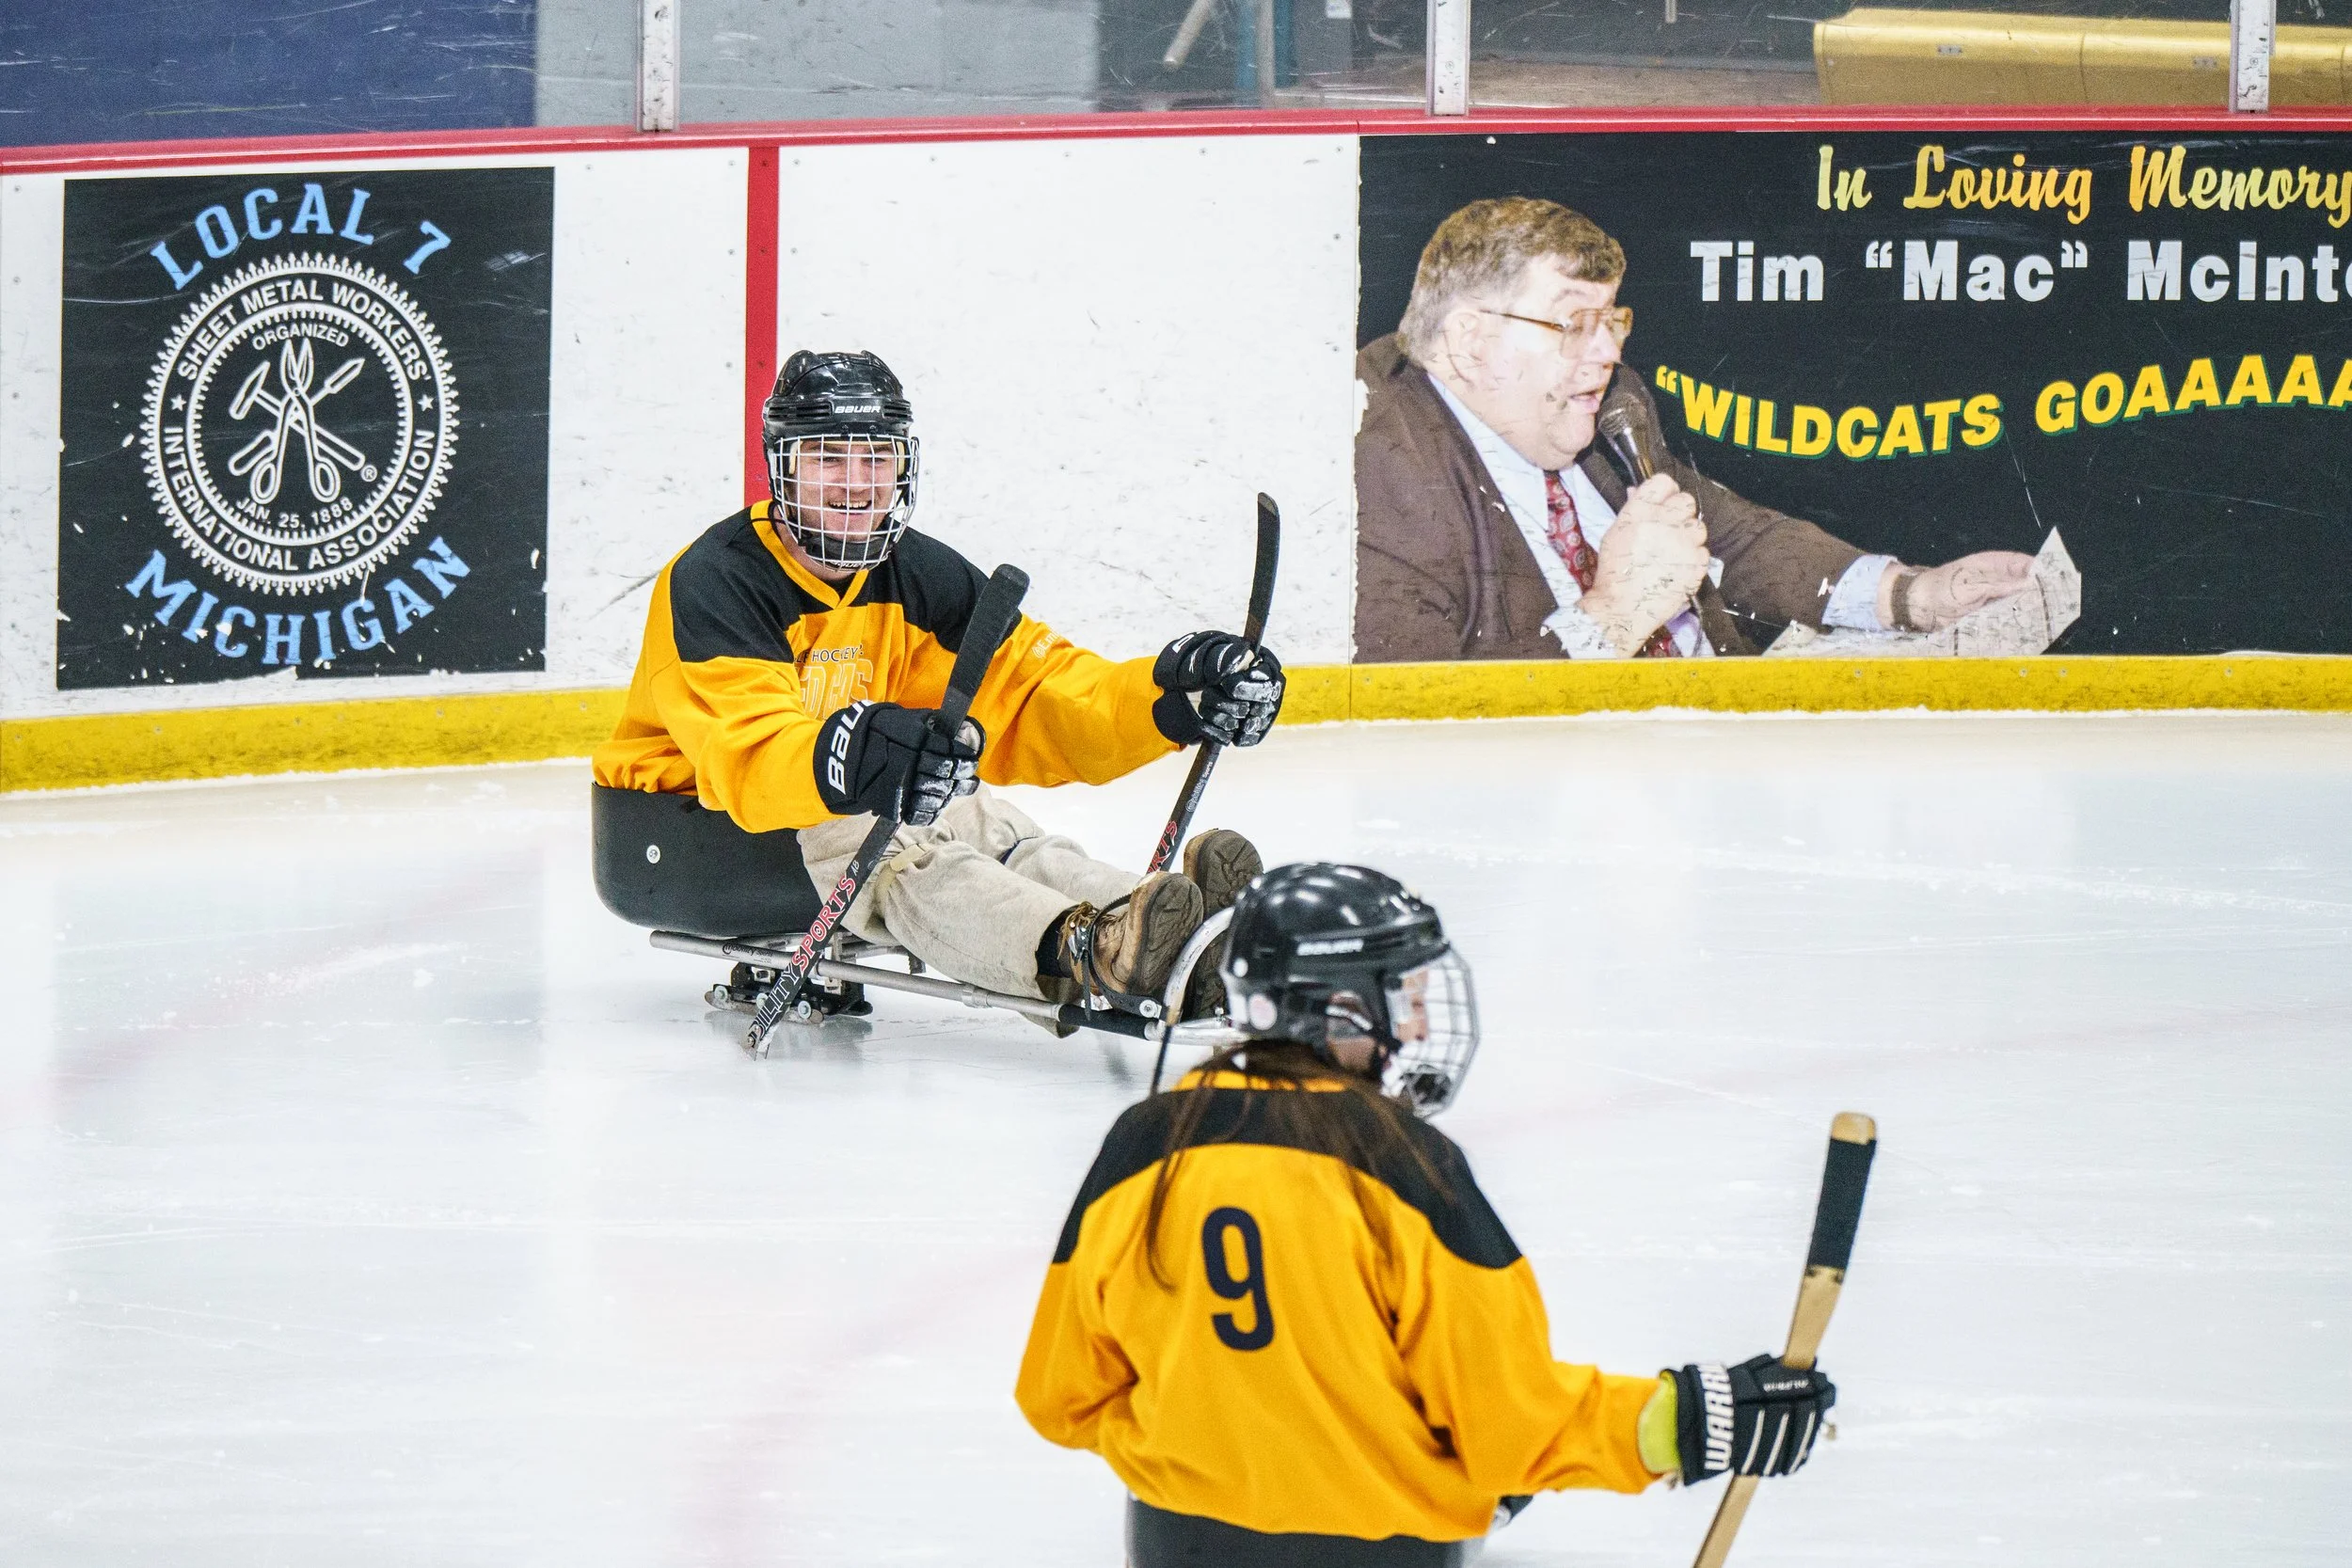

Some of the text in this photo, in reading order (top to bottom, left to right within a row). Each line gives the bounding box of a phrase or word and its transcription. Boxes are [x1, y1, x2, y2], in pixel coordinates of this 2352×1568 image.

[151, 182, 452, 290] LOCAL 7
[1816, 144, 2352, 229] In Loving Memory
[1690, 240, 2352, 303] Tim “Mac” McInt
[176, 305, 243, 381] SHEET
[240, 278, 324, 315] METAL
[251, 323, 350, 352] ORGANIZED
[1655, 364, 2005, 462] “WILDCATS
[164, 425, 435, 571] INTERNATIONAL ASSOCIATION
[235, 496, 272, 525] JAN.
[310, 496, 354, 526] 1888
[124, 536, 470, 666] MICHIGAN
[1200, 1206, 1276, 1352] 9
